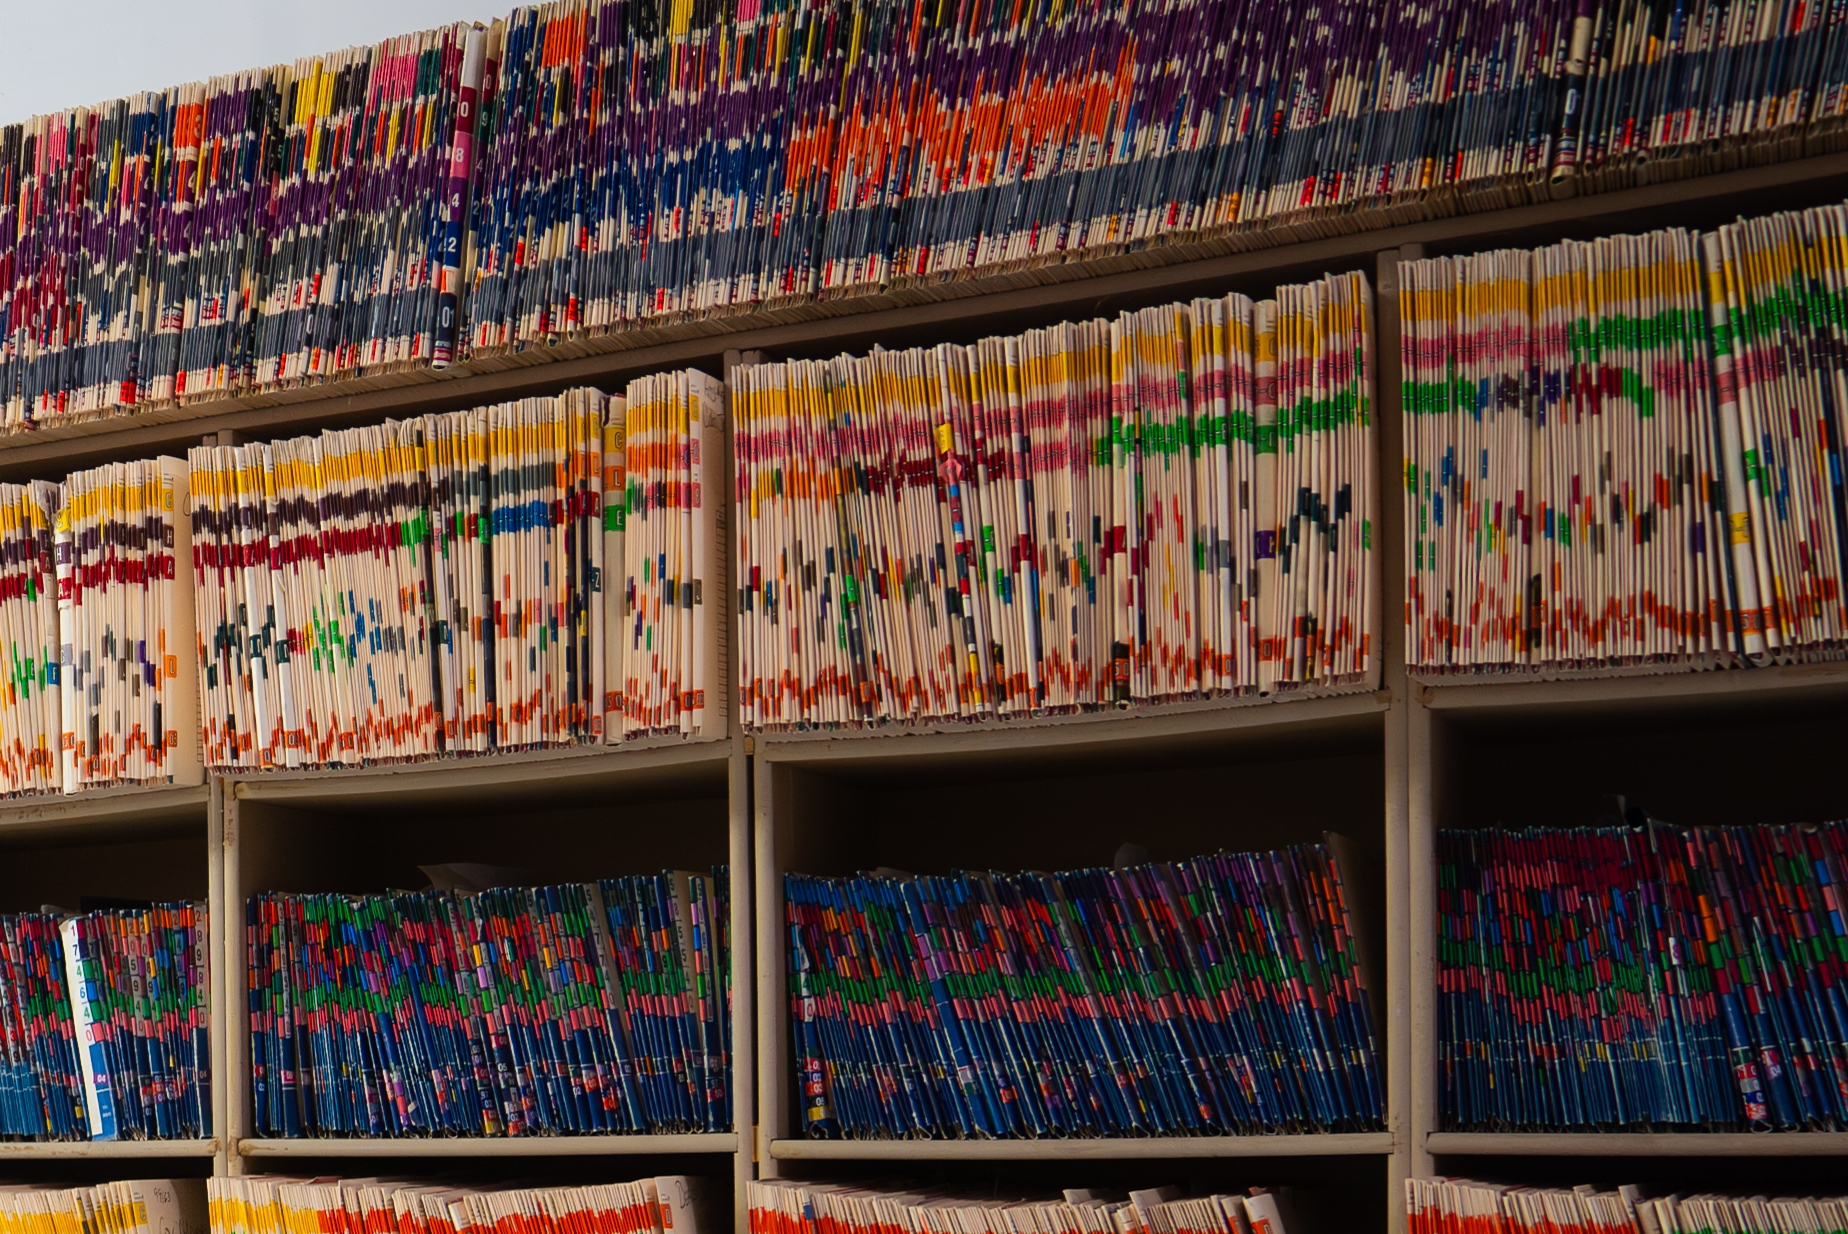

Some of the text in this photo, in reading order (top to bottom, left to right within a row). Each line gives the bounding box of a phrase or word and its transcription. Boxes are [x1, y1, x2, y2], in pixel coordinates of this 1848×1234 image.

[481, 111, 488, 126] 9
[447, 101, 469, 253] 0 8 4 2
[472, 200, 480, 216] 2
[615, 431, 624, 450] C
[613, 469, 621, 487] L
[615, 508, 624, 527] E
[166, 529, 173, 545] H
[55, 545, 63, 562] H
[166, 560, 174, 575] A
[195, 909, 201, 922] 2
[197, 929, 203, 942] 8
[594, 932, 600, 945] 7
[196, 948, 202, 962] 9
[130, 958, 137, 971] 5
[133, 979, 139, 992] 9
[198, 971, 204, 985] 8
[198, 989, 204, 1002] 4
[70, 924, 107, 1084] 1 7 4 6 4 0 04
[199, 1011, 206, 1025] 0
